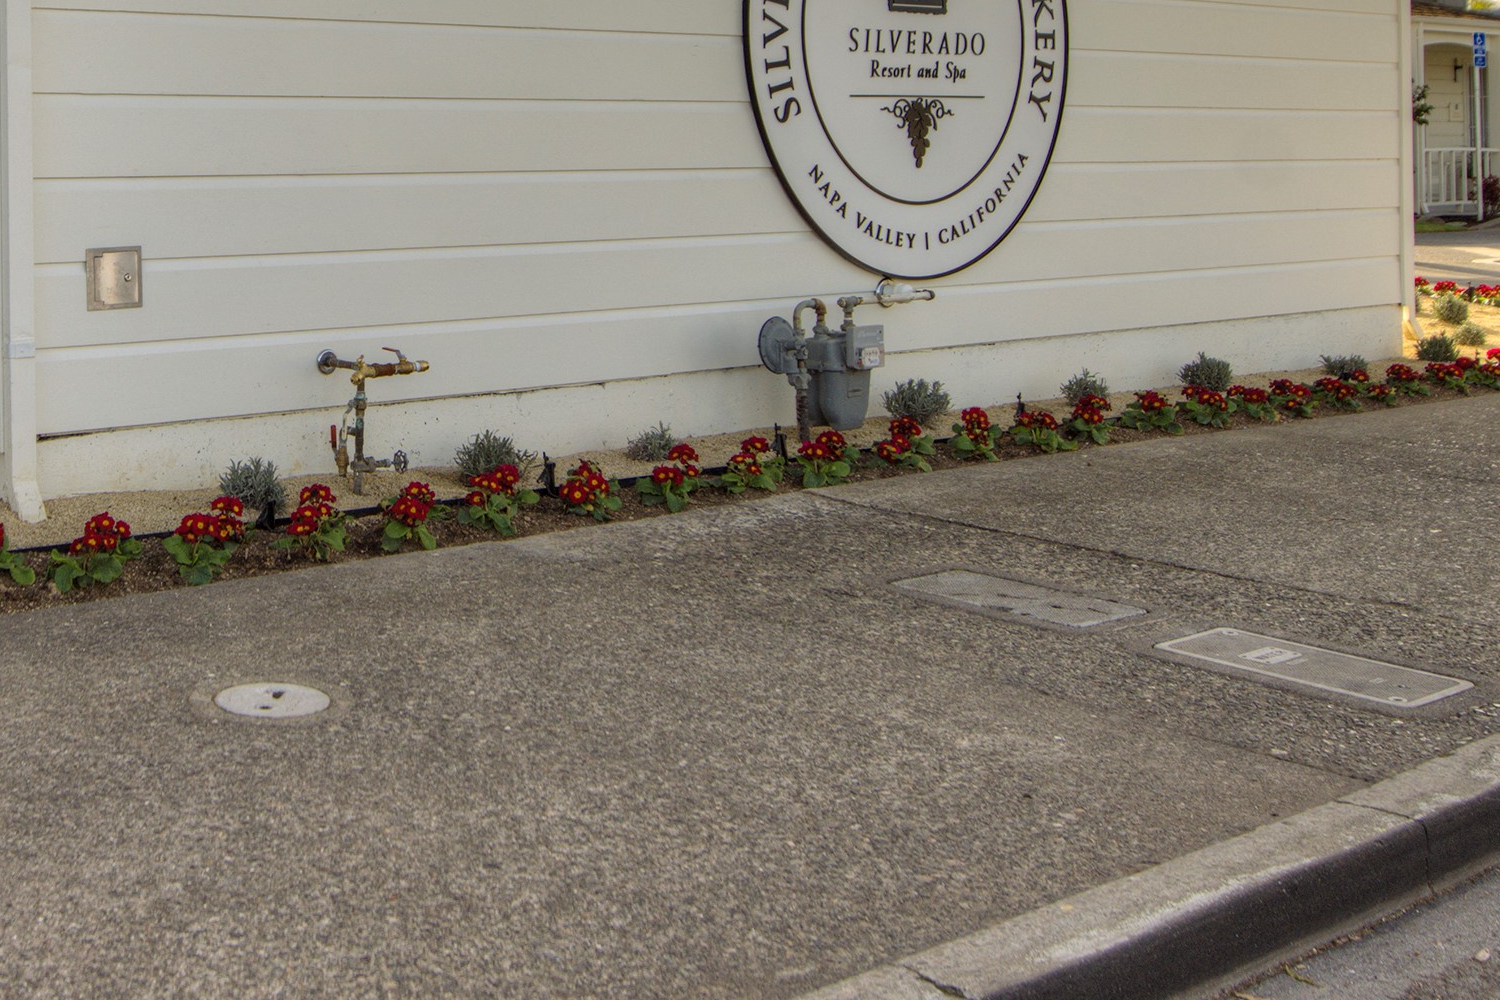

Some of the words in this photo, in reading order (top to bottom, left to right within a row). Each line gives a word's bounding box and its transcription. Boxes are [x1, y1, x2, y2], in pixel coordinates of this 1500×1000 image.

[848, 26, 987, 58] SILVERADO
[869, 59, 912, 80] Resort
[916, 60, 939, 80] and
[944, 60, 968, 82] Spa
[807, 162, 848, 219] NAPA
[855, 211, 916, 250] VALLEY
[937, 151, 1031, 247] CALIFORNIA
